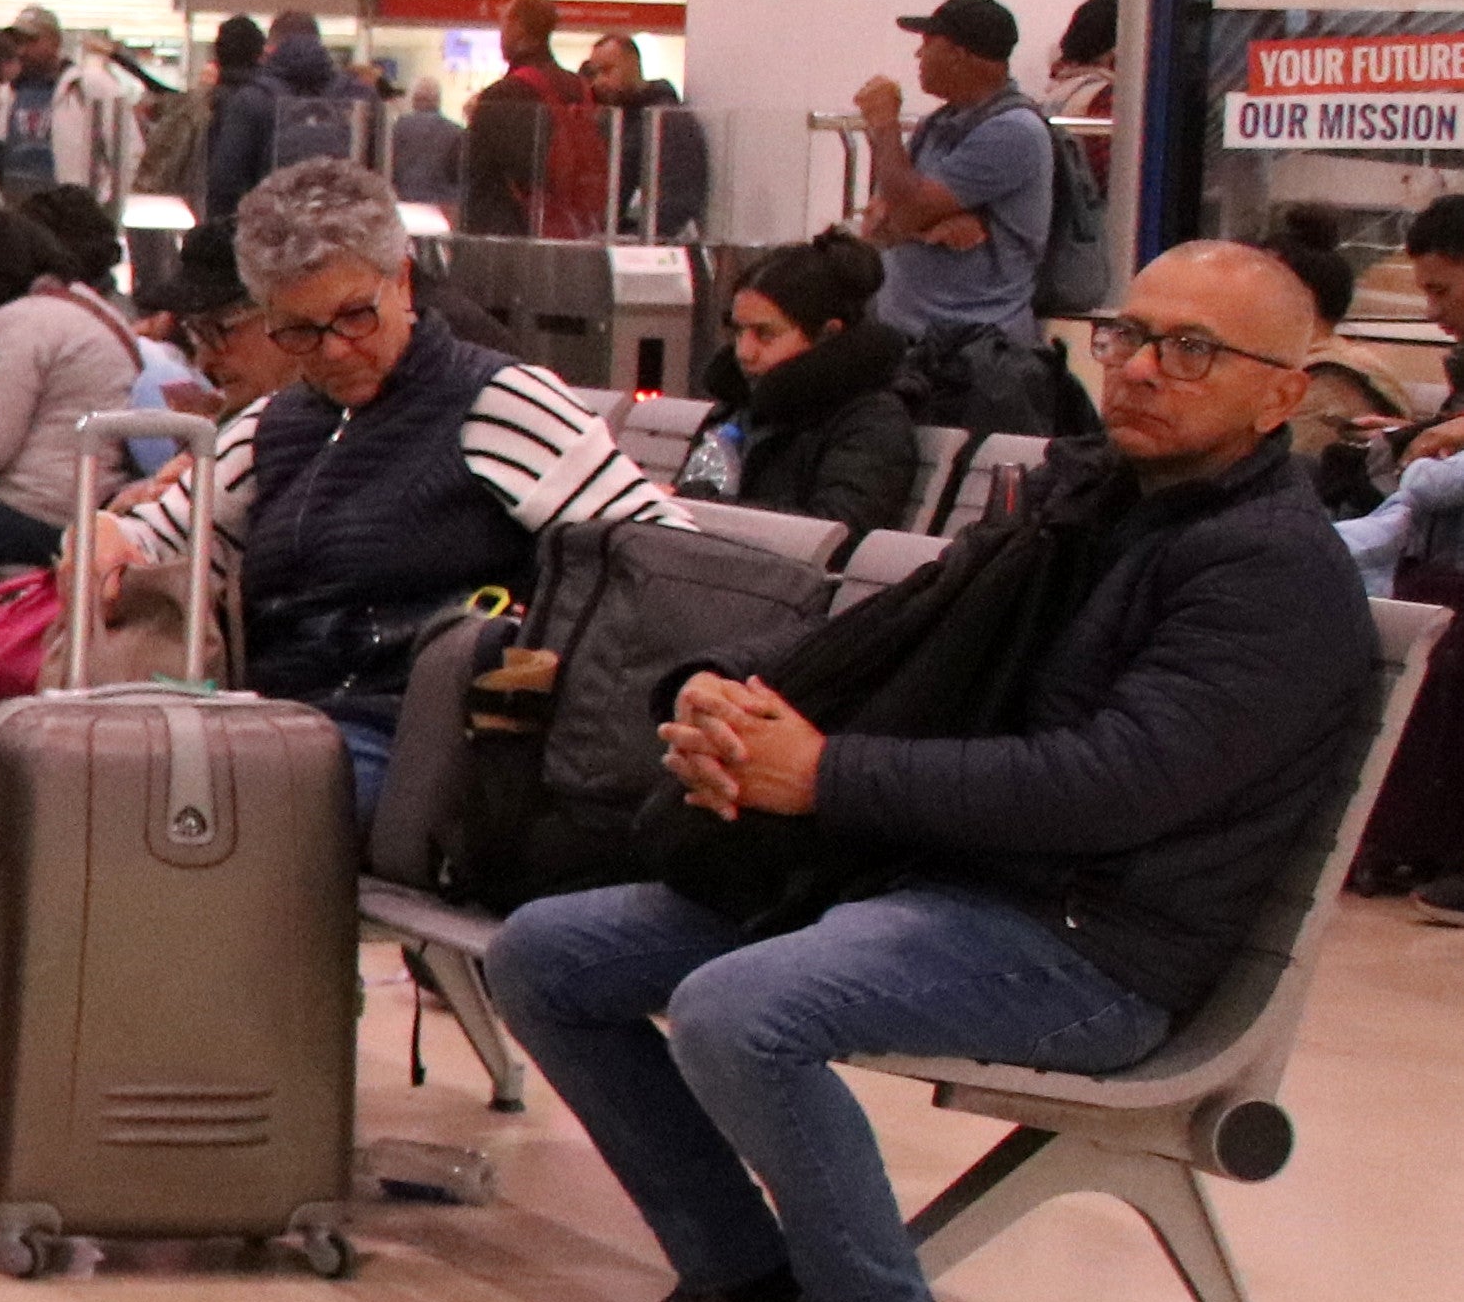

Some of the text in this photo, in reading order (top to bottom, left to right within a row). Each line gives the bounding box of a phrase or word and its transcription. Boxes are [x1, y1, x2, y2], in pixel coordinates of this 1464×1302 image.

[1259, 39, 1464, 88] YOUR FUTURE
[1238, 100, 1456, 142] OUR MISSION
